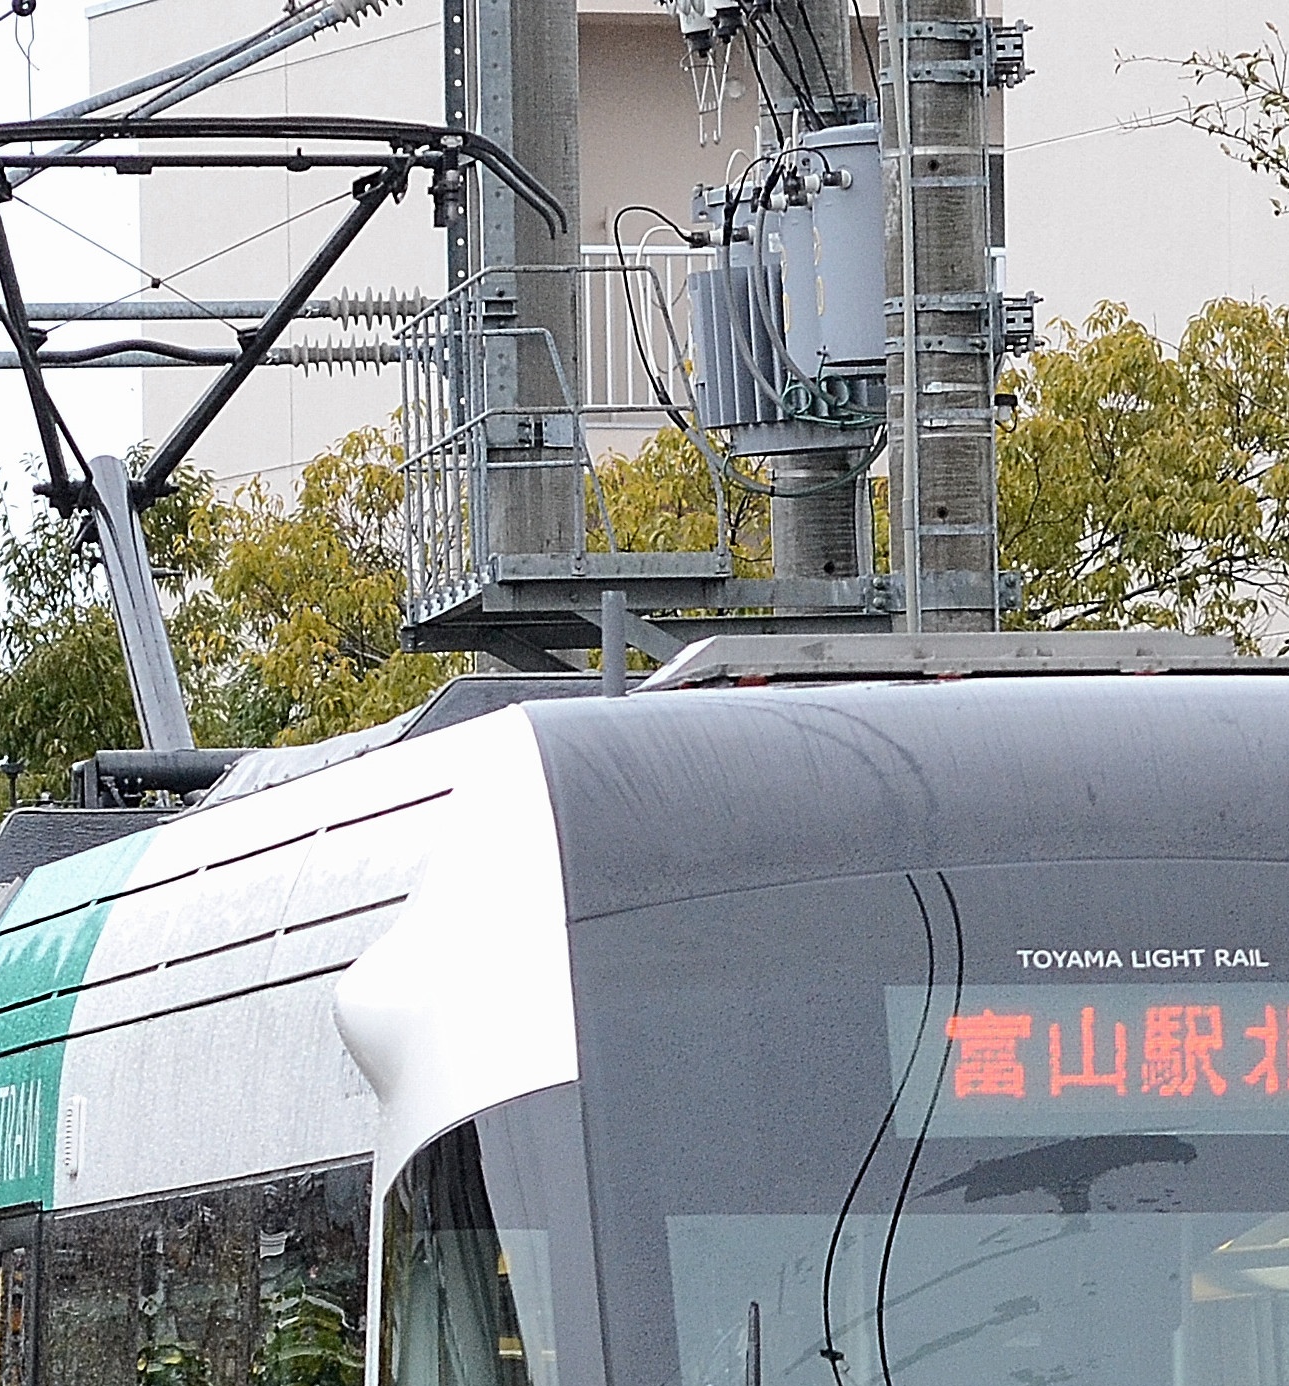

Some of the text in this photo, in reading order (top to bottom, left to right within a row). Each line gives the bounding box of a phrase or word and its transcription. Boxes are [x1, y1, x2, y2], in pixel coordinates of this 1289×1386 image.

[1015, 948, 1270, 969] TOYAMA LIGHT RAIL
